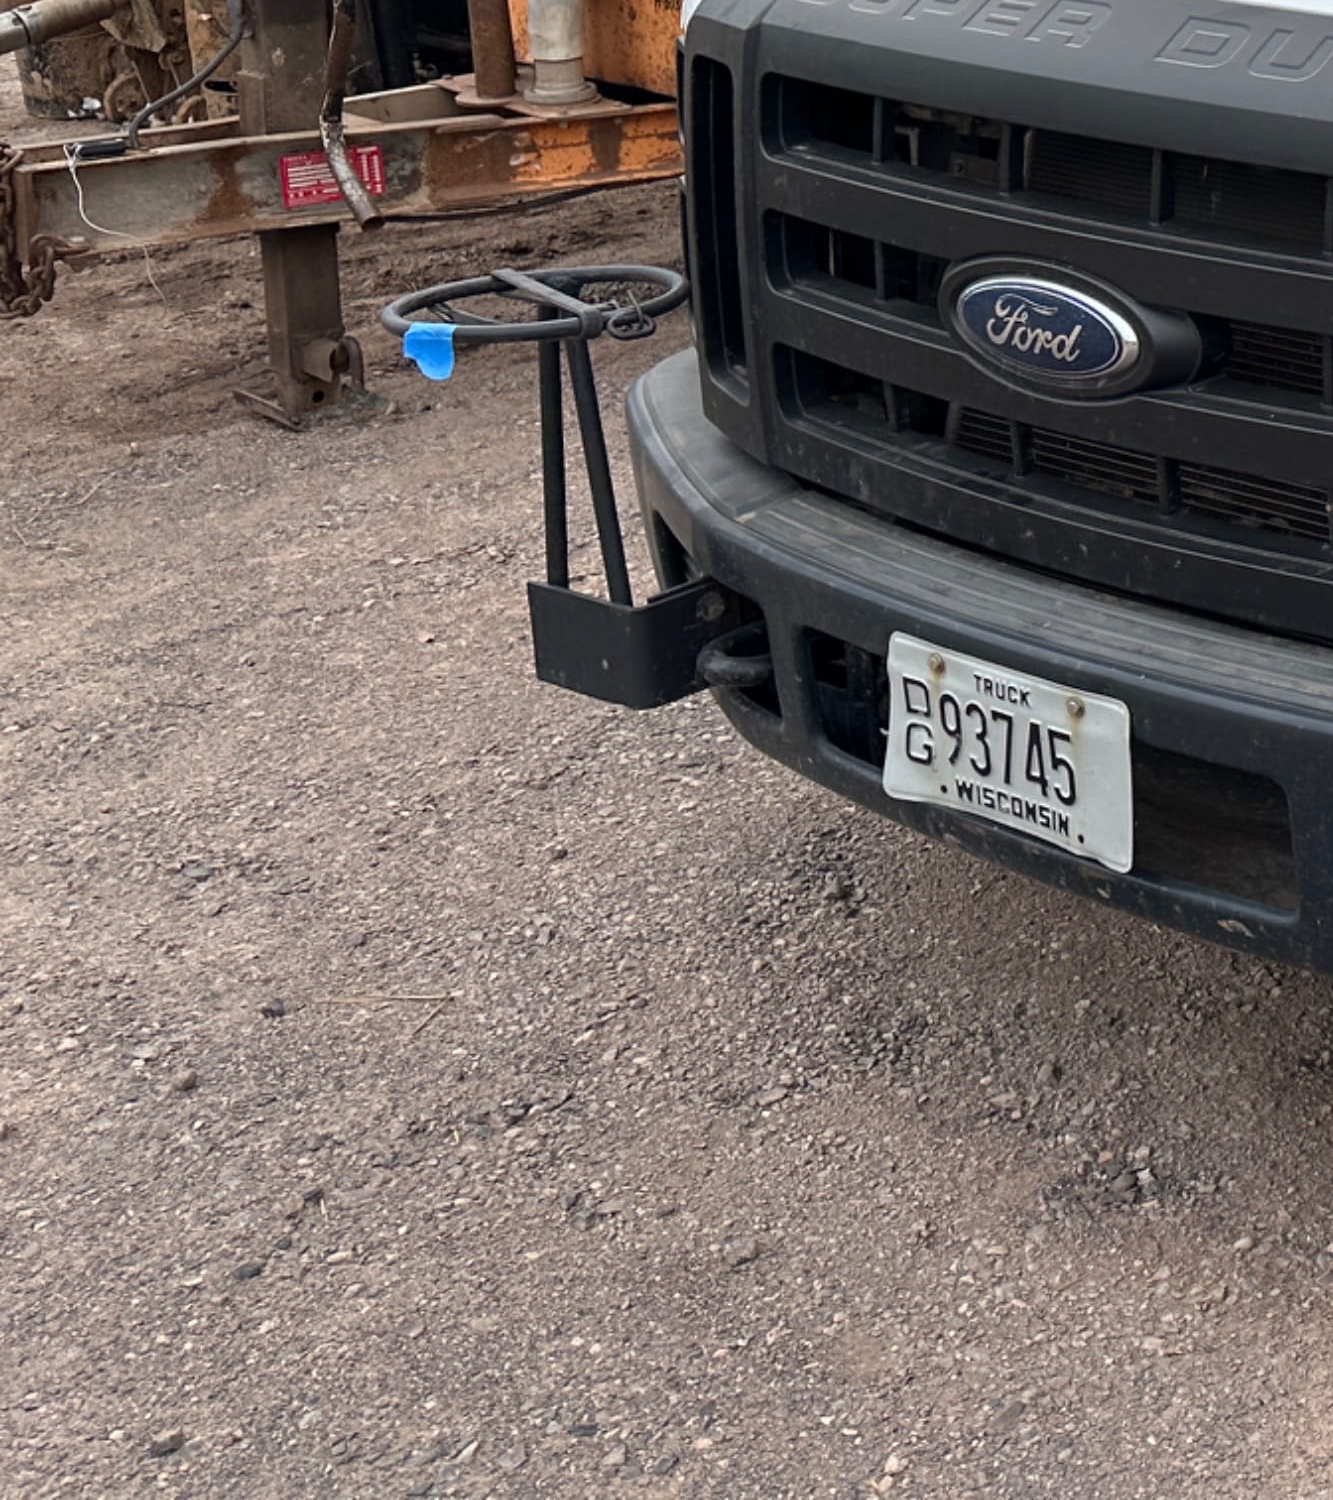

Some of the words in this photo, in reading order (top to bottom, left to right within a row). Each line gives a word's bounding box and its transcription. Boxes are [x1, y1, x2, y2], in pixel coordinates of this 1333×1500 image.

[986, 292, 1083, 363] Ford
[973, 673, 1031, 708] TRUCK
[955, 778, 1071, 838] WISCONSIN
